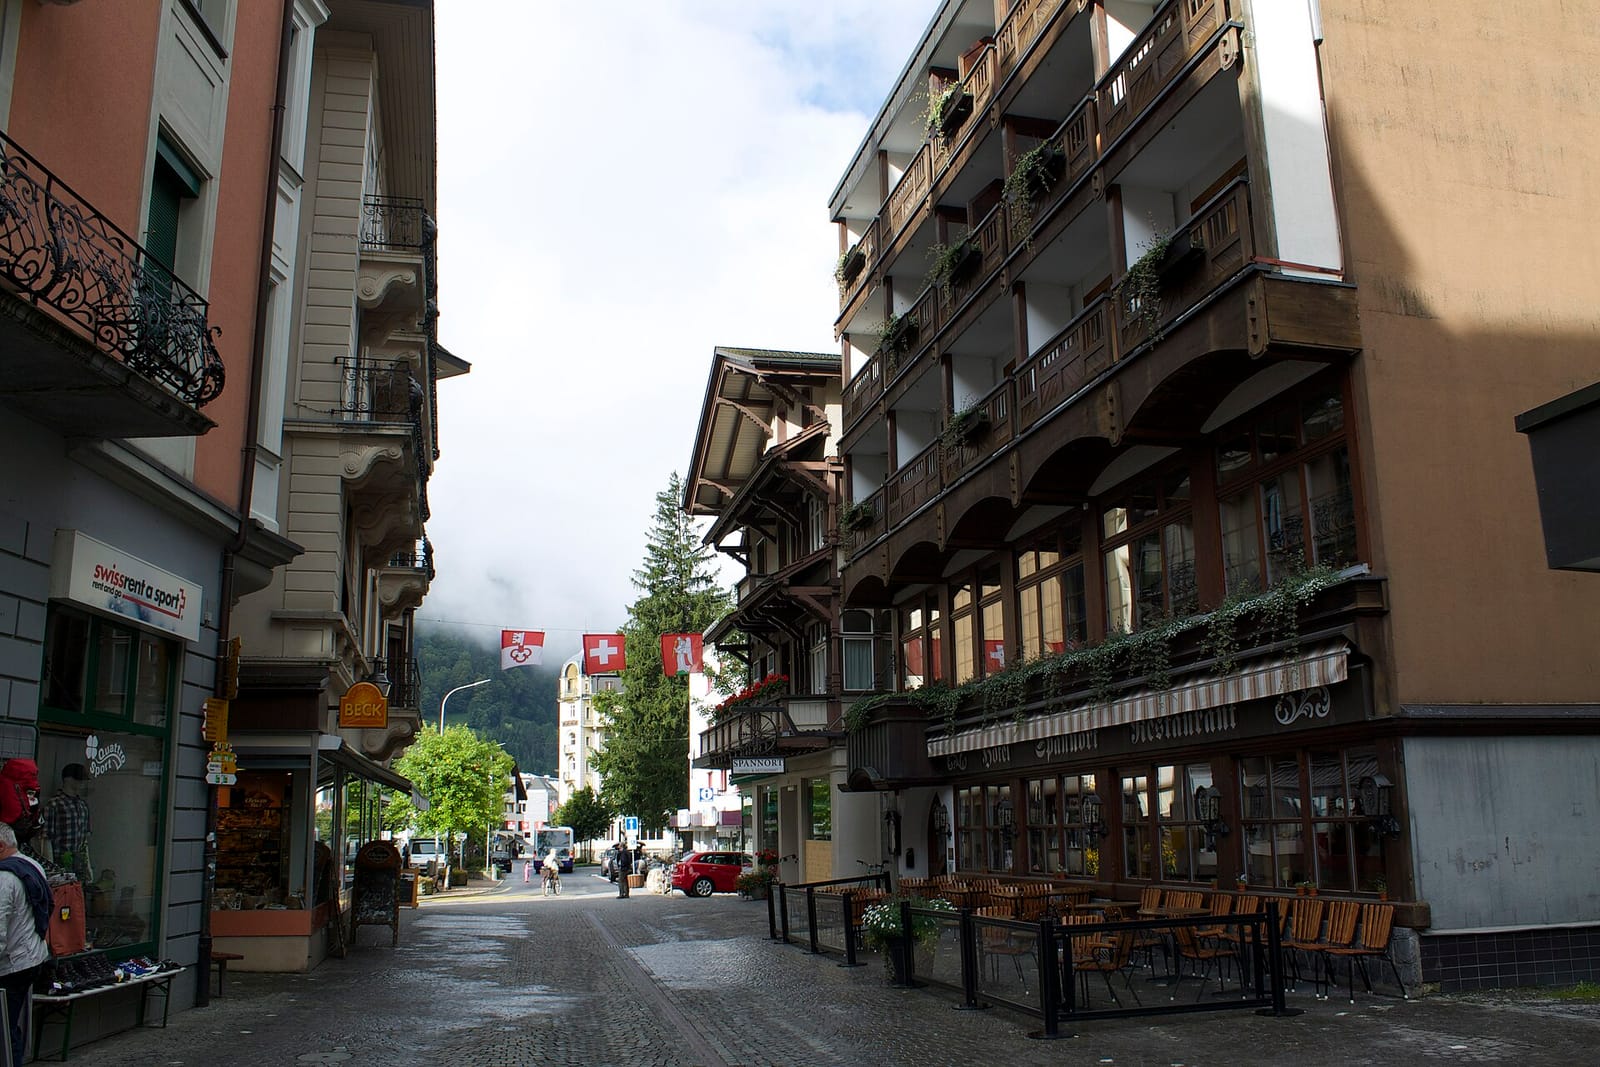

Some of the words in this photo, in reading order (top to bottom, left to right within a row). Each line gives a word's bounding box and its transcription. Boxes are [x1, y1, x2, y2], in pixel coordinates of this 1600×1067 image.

[92, 580, 104, 589] rent
[104, 584, 114, 595] and
[114, 589, 122, 599] go
[94, 564, 145, 595] swissrent
[146, 585, 153, 599] a
[154, 588, 179, 609] sport
[344, 703, 382, 717] BECK
[98, 743, 126, 763] Quattro
[89, 758, 111, 778] Sport
[733, 759, 782, 767] SPANNORT
